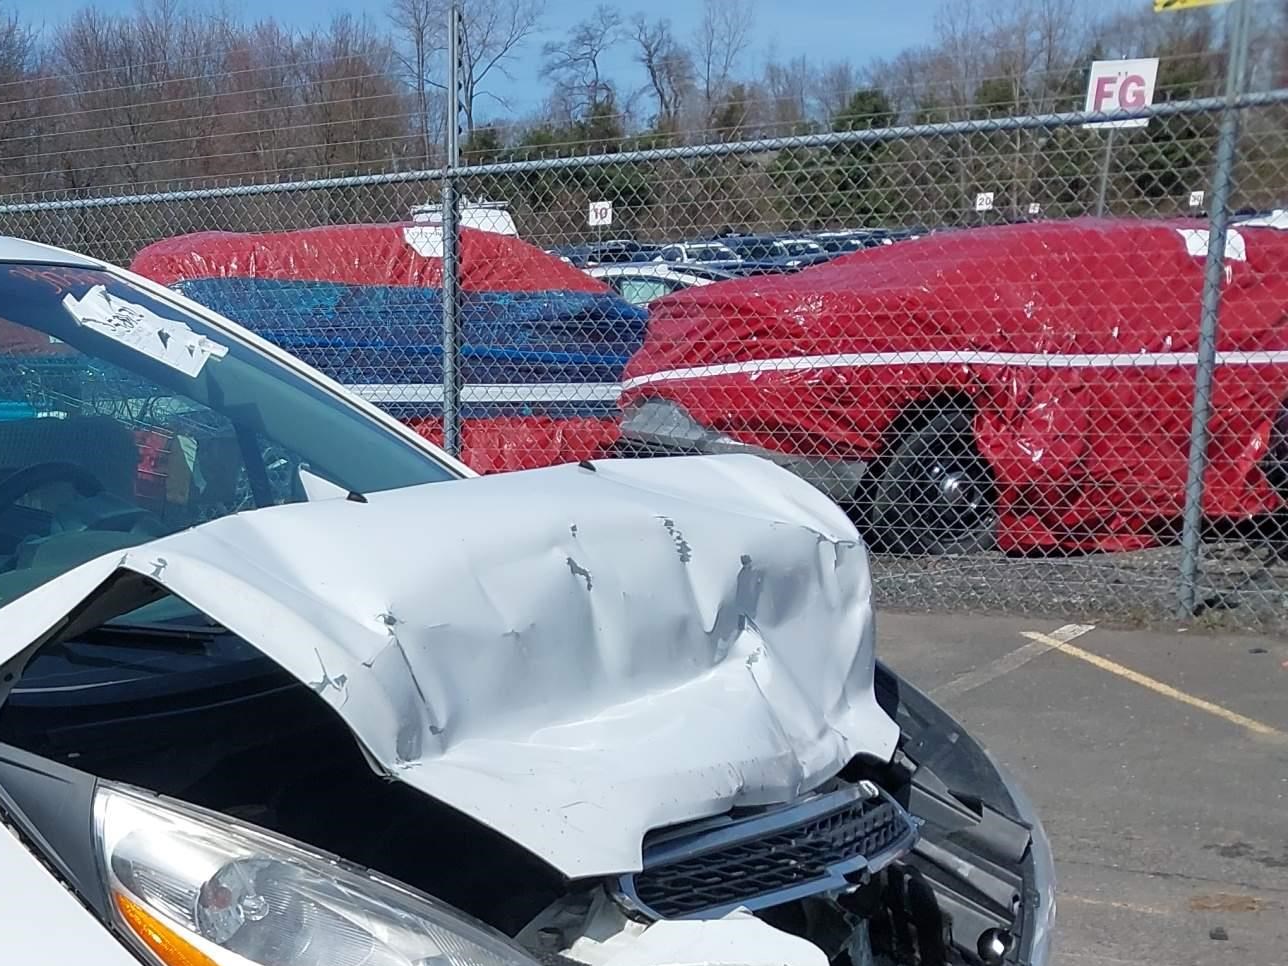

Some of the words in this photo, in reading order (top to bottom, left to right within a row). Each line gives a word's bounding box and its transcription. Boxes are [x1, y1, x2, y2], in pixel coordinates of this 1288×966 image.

[1093, 74, 1146, 112] FG
[977, 196, 992, 206] 20
[593, 207, 608, 220] 10
